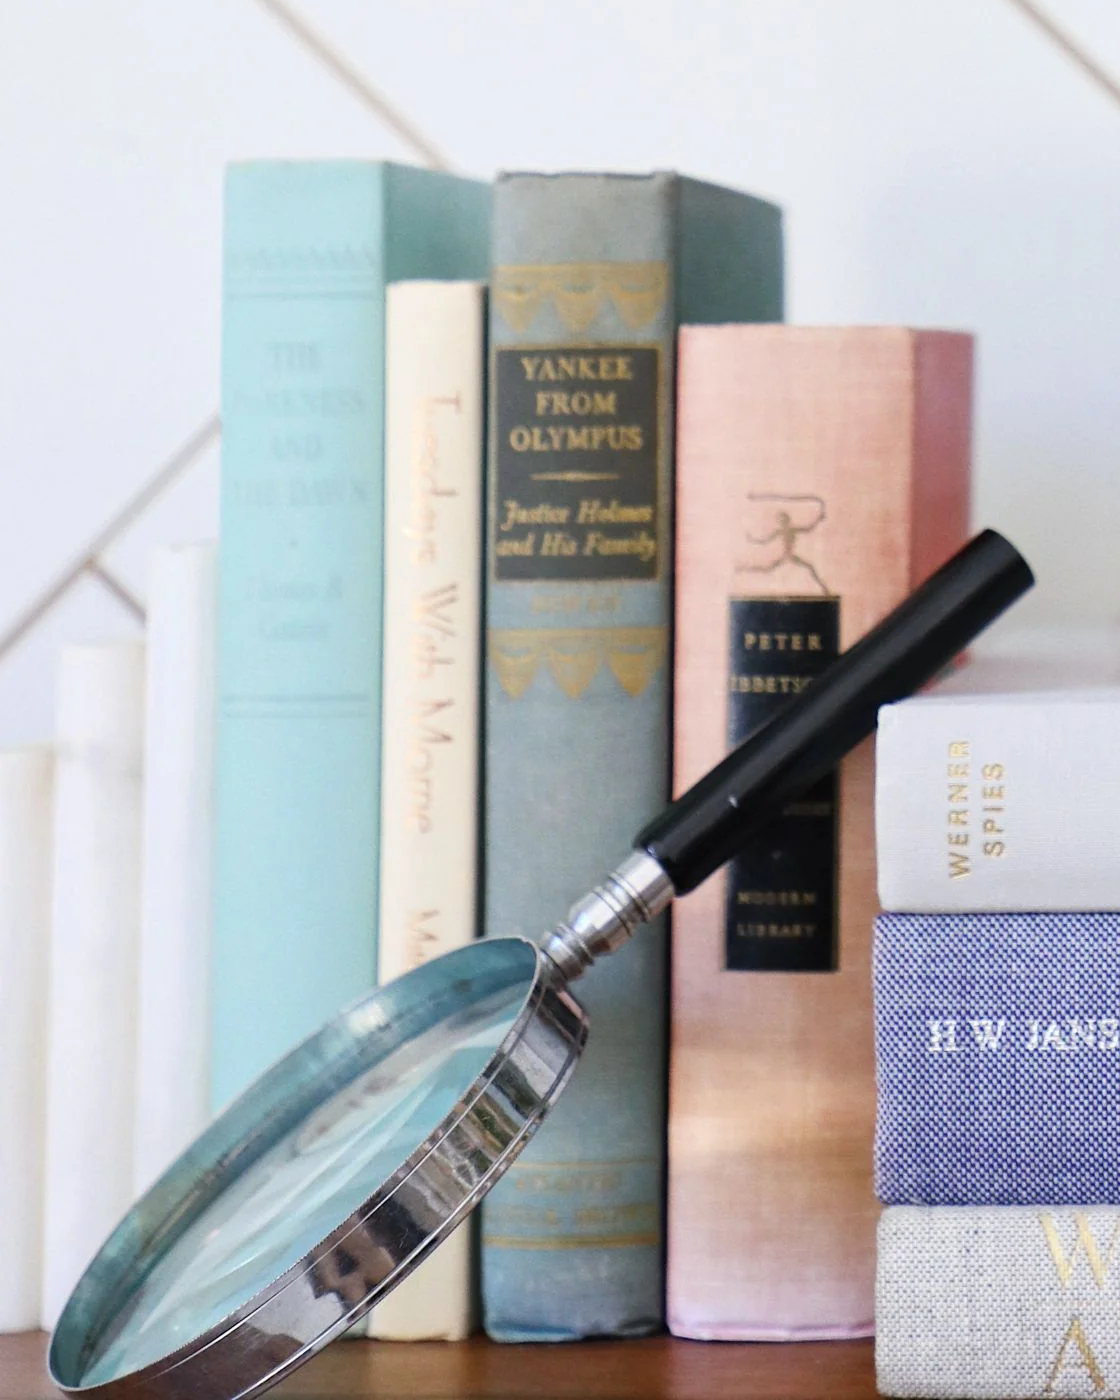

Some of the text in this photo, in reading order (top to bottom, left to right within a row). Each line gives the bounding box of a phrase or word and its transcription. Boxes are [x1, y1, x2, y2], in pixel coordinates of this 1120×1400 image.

[521, 356, 633, 381] YANKEE
[536, 391, 617, 416] FROM
[509, 425, 643, 451] OLYMPUS
[501, 499, 654, 531] Justice Holmes
[497, 530, 657, 562] and His Family
[744, 632, 822, 651] PETER
[948, 740, 972, 880] WERNER
[981, 763, 1005, 857] SPIES
[736, 922, 815, 938] LIBRARY
